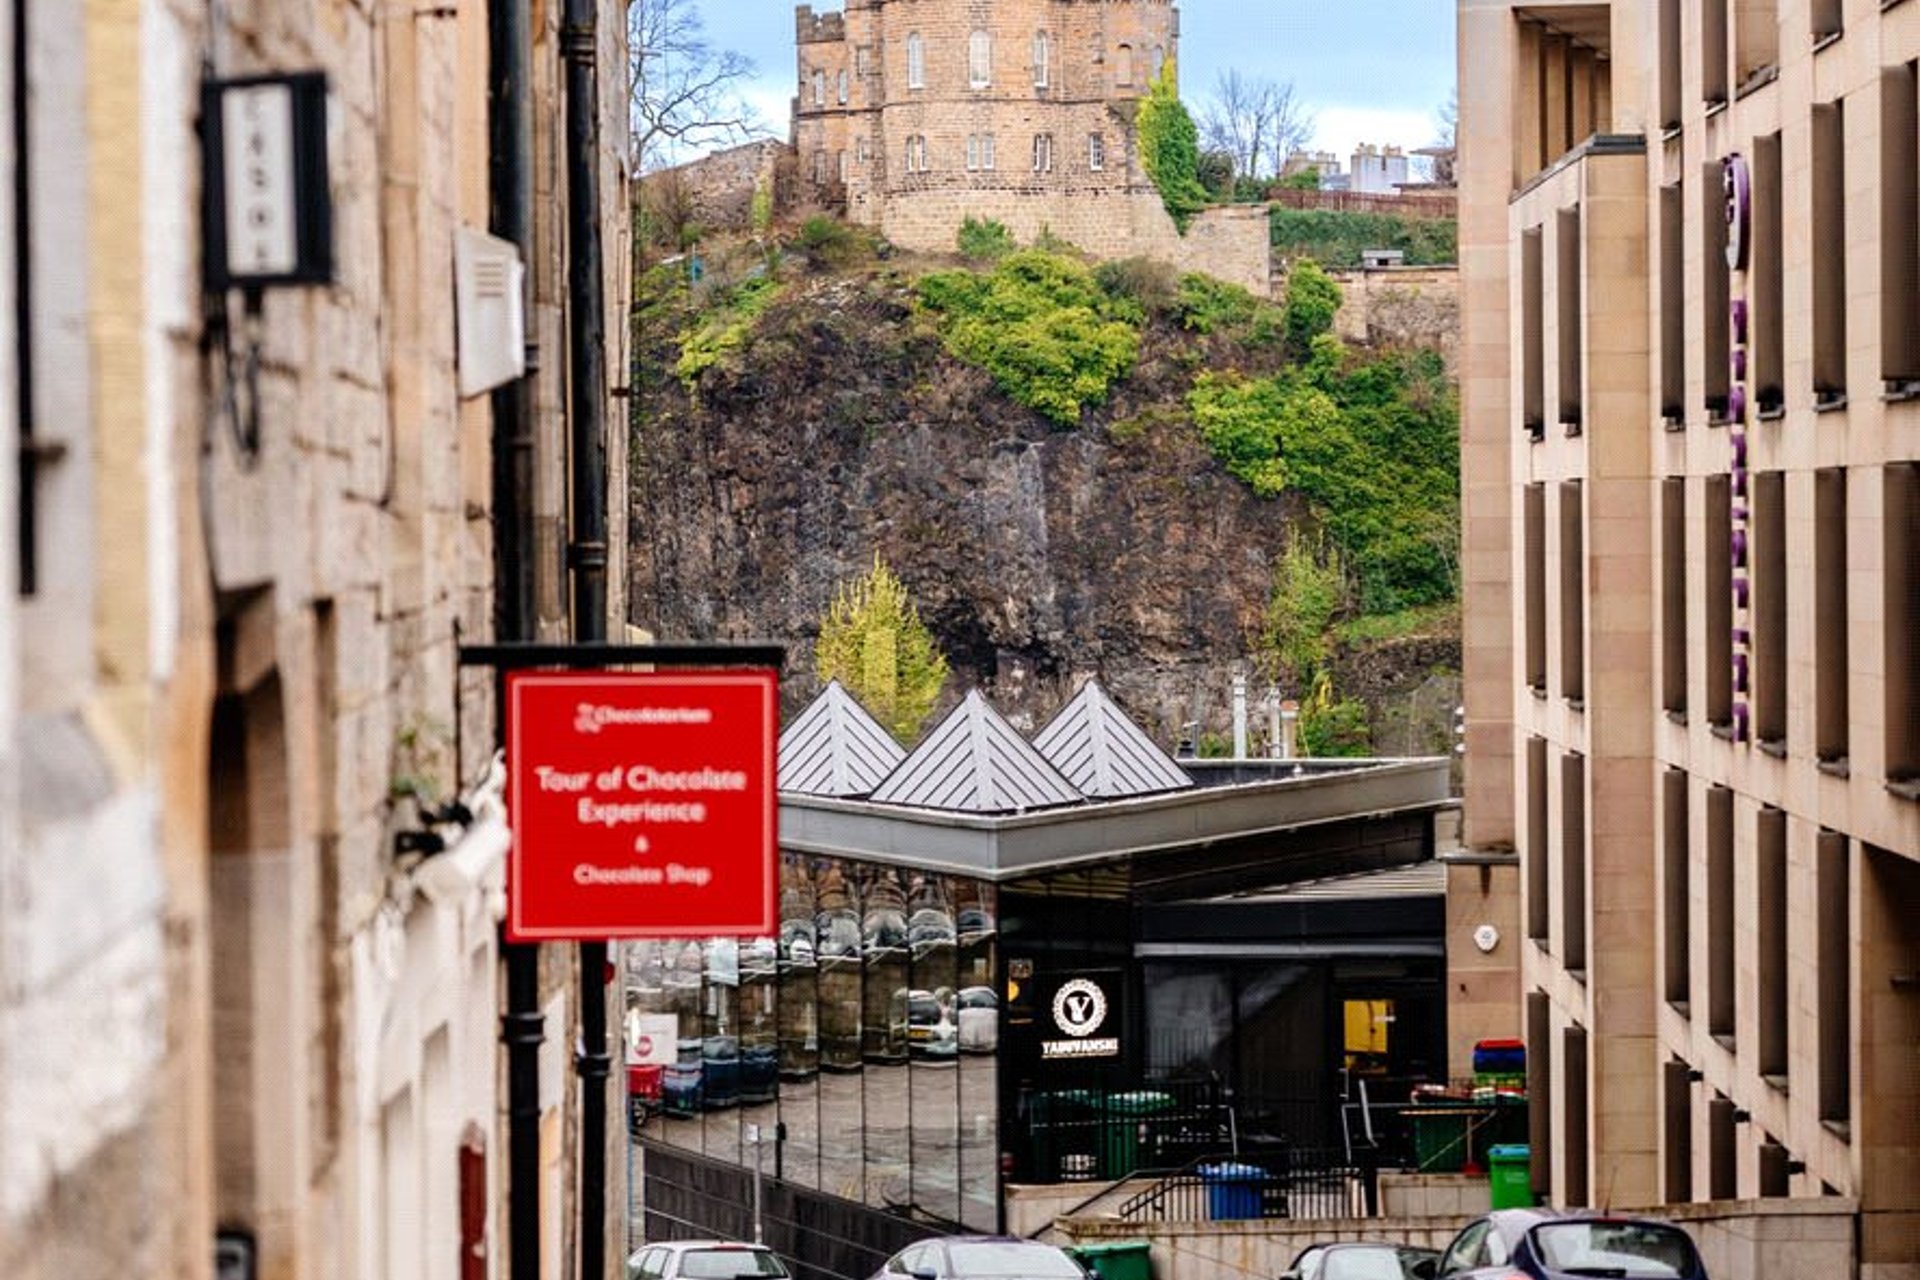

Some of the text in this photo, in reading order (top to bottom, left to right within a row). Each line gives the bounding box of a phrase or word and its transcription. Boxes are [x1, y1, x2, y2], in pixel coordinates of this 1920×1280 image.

[535, 765, 747, 791] Tour of Chocolate
[578, 797, 706, 827] Experience
[573, 863, 711, 886] Chocolate Shop
[1066, 996, 1092, 1022] Y
